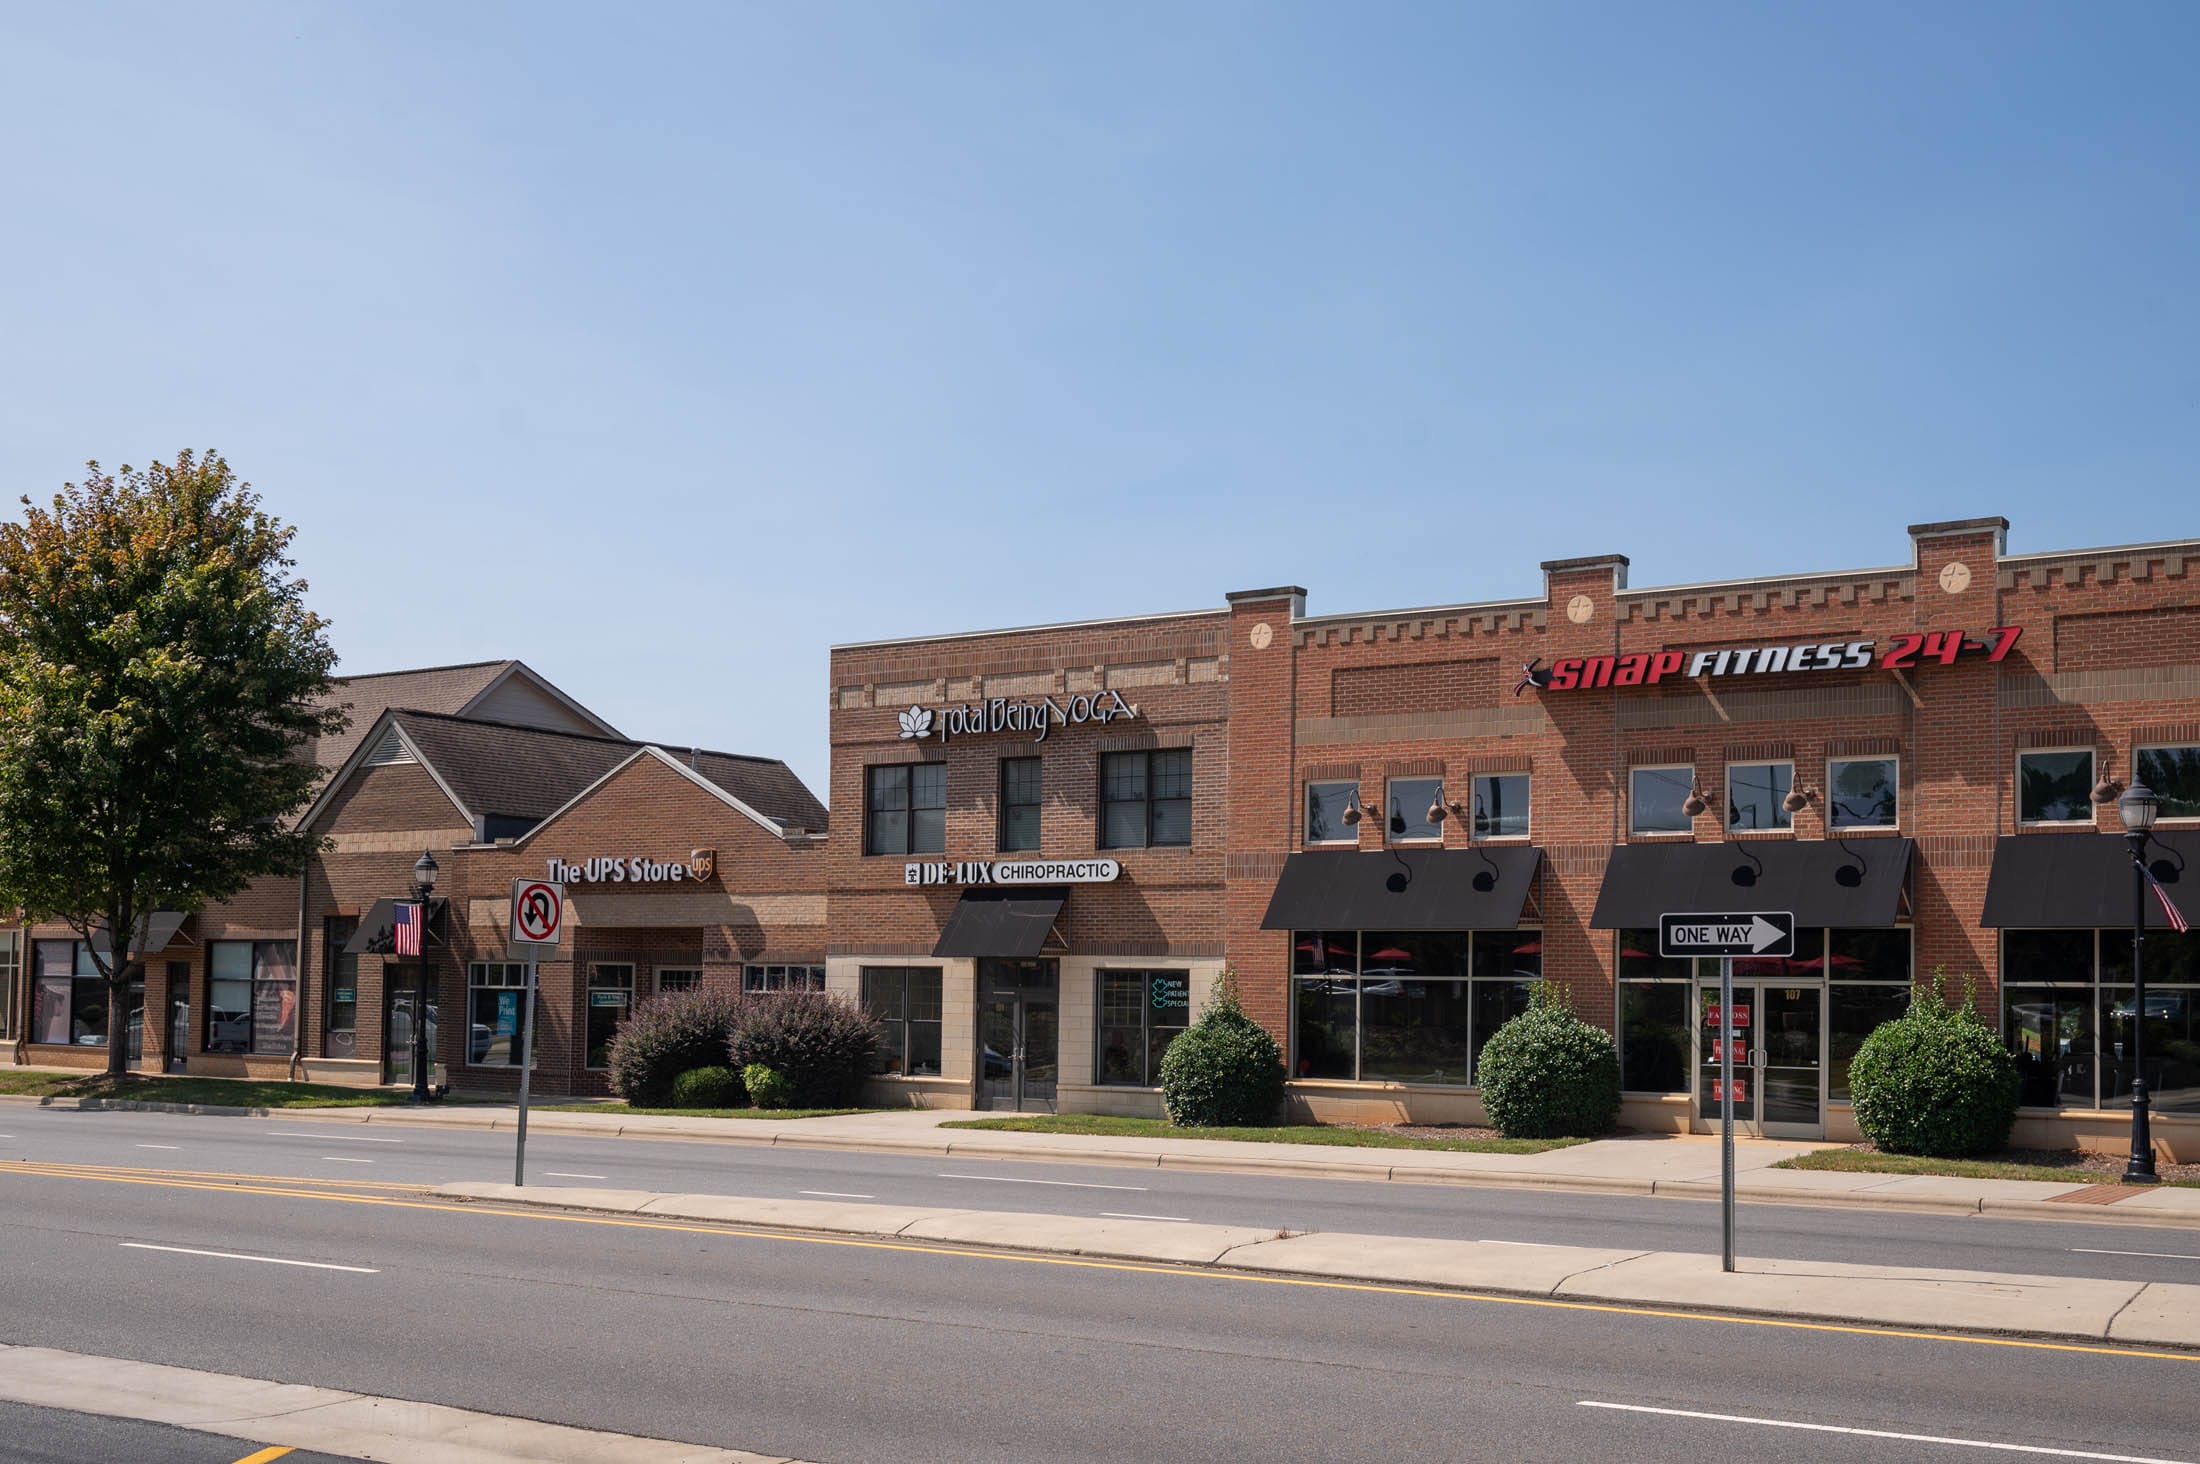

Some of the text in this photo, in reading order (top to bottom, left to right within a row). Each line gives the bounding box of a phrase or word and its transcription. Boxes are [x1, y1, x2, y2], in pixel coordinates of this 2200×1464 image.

[1880, 626, 2023, 669] 24-7
[938, 689, 1135, 743] Total Being YOGA
[547, 857, 683, 883] The UPS Store
[922, 862, 1111, 884] DE-LUX CHIROPRACTIC
[1675, 926, 1753, 943] ONE WAY
[1167, 980, 1183, 988] NEW
[1784, 989, 1801, 1001] 107
